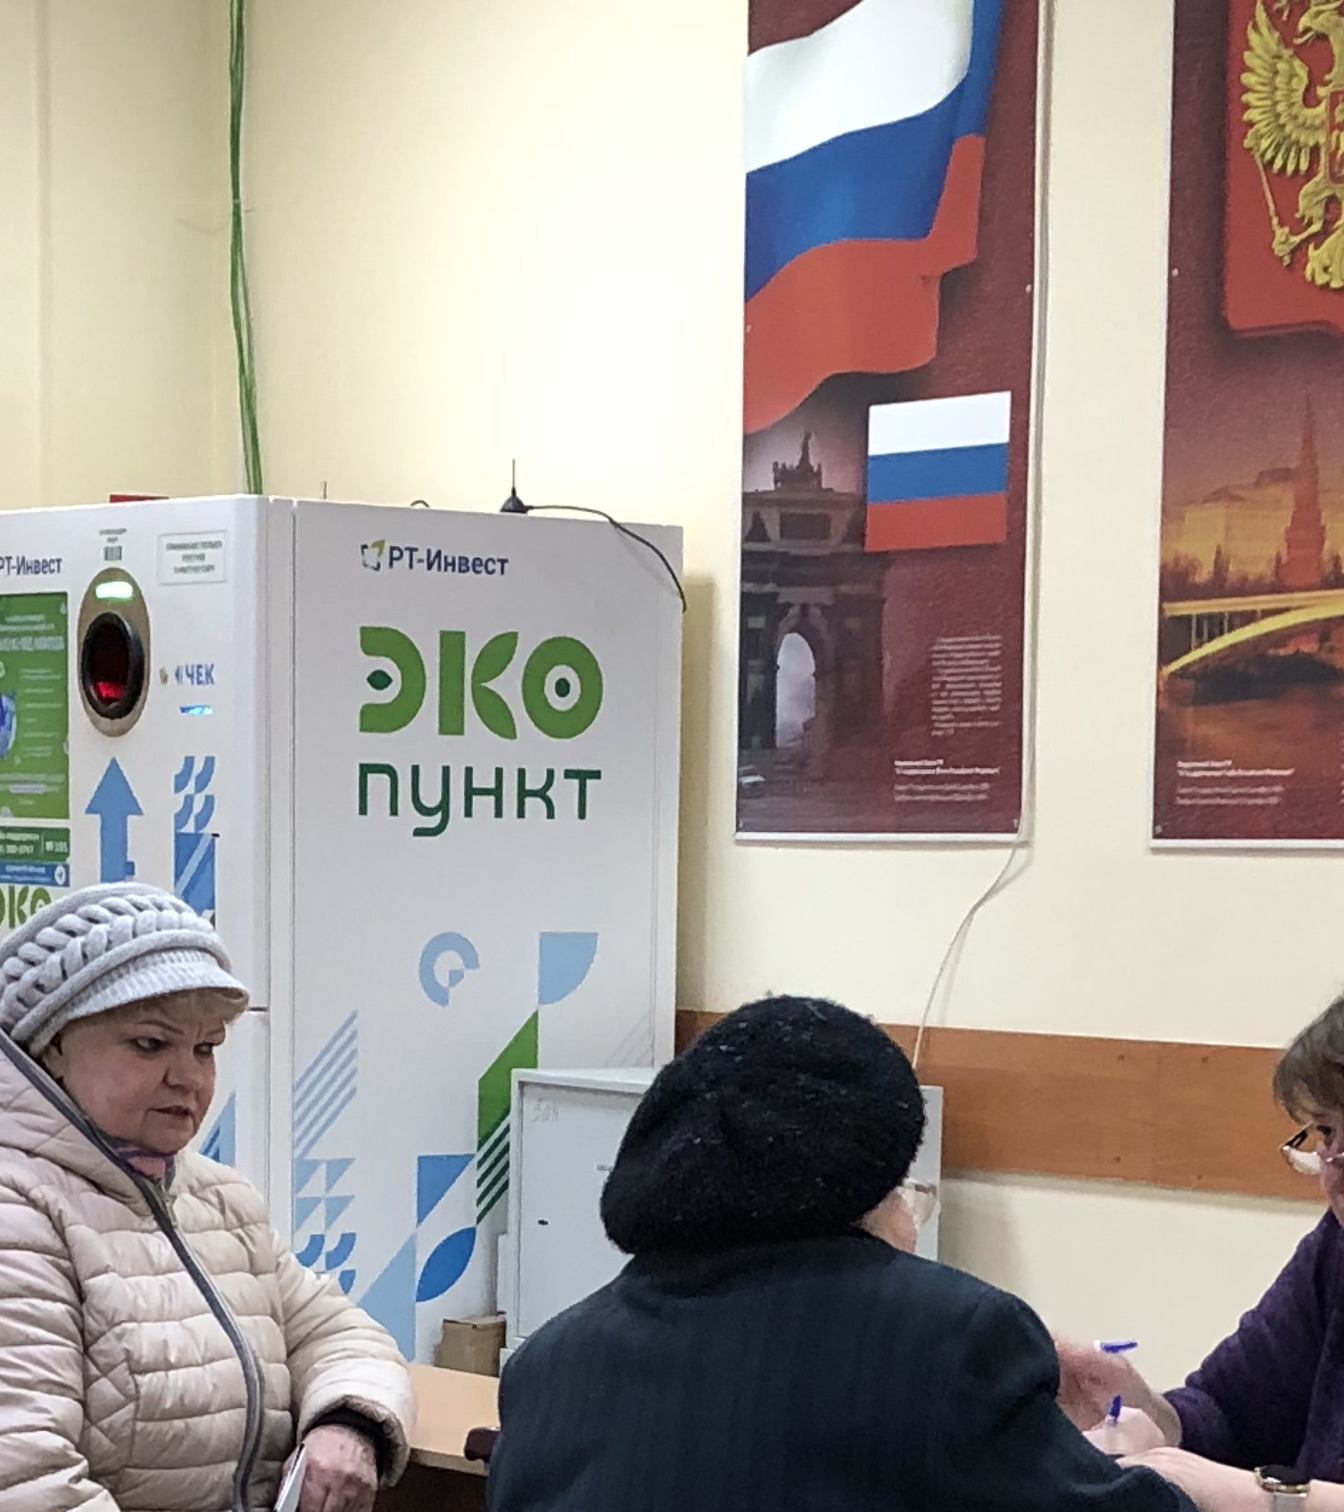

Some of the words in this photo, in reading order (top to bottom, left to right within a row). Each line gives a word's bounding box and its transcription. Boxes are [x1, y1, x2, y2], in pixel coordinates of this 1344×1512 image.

[388, 545, 509, 576] РТ-Инвест
[185, 663, 215, 686] ЧЕК
[359, 625, 604, 741] ЭКО
